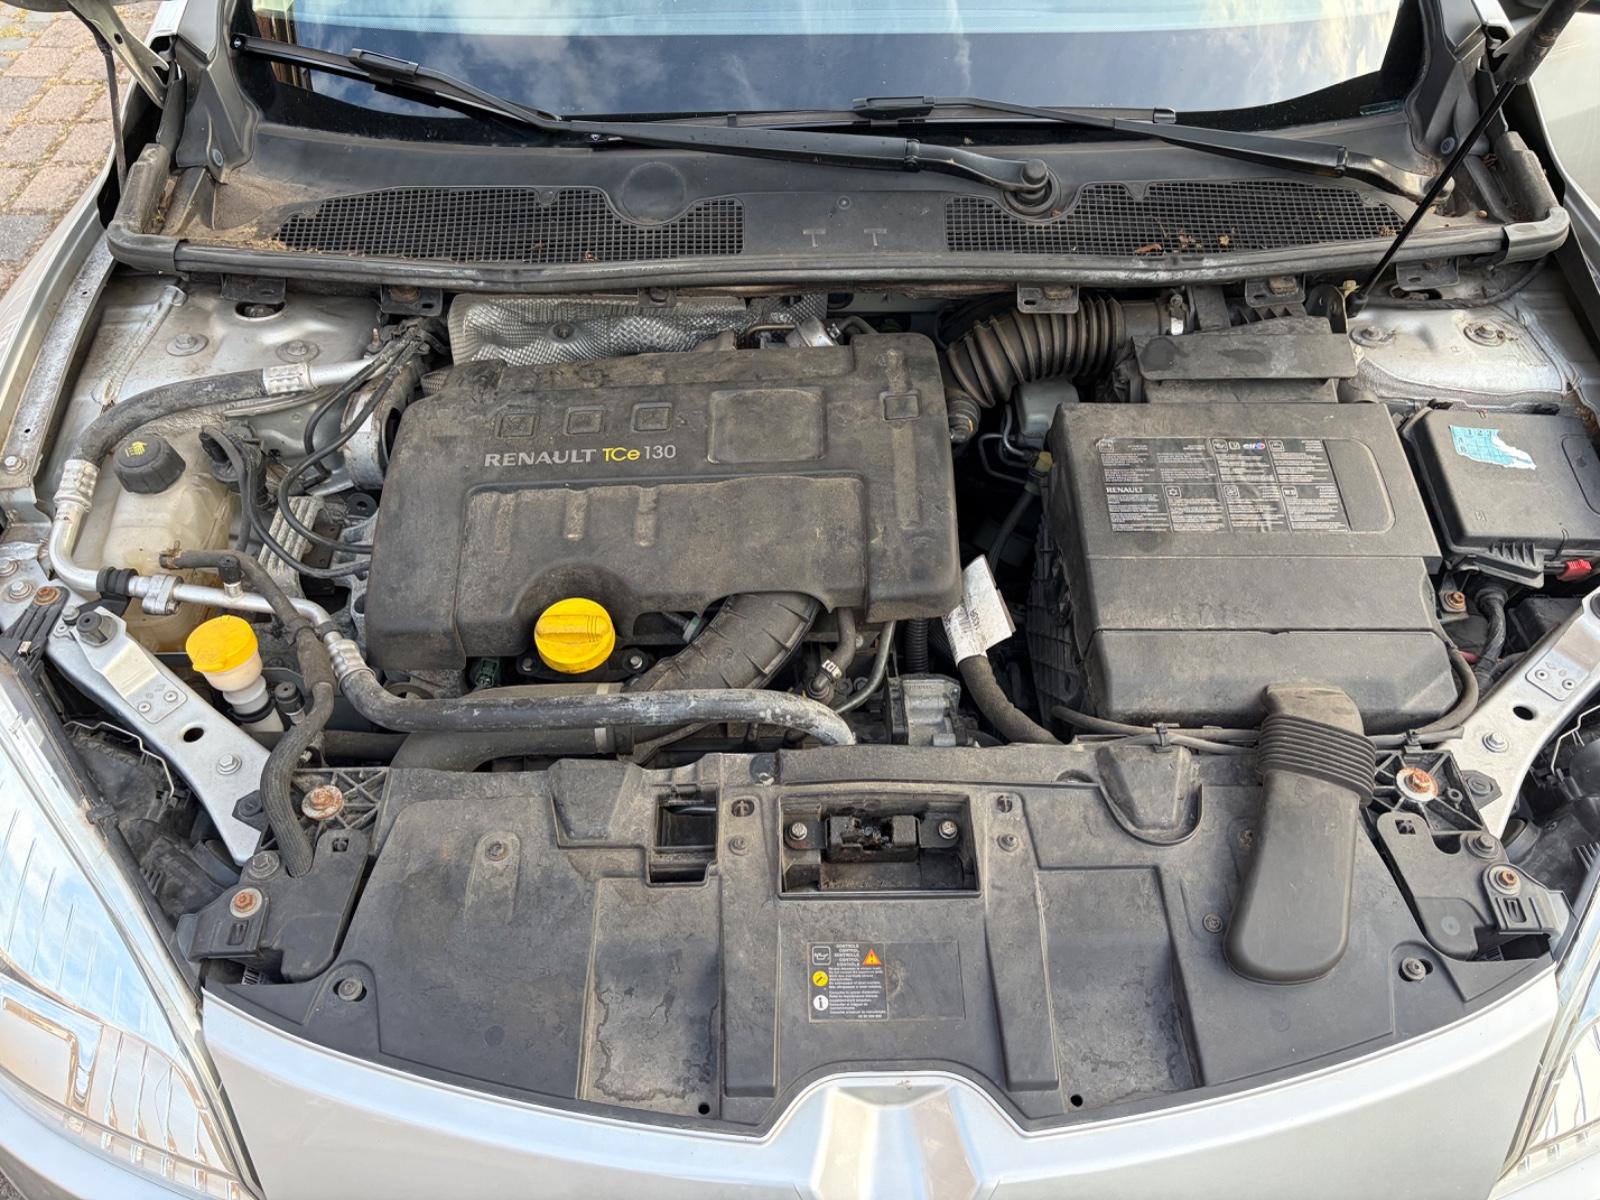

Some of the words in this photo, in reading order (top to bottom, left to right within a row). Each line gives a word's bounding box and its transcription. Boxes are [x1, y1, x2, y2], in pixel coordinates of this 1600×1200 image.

[483, 449, 597, 467] RENAULT
[602, 447, 641, 462] TCe
[644, 444, 677, 460] 130
[1105, 486, 1145, 494] RENAULT
